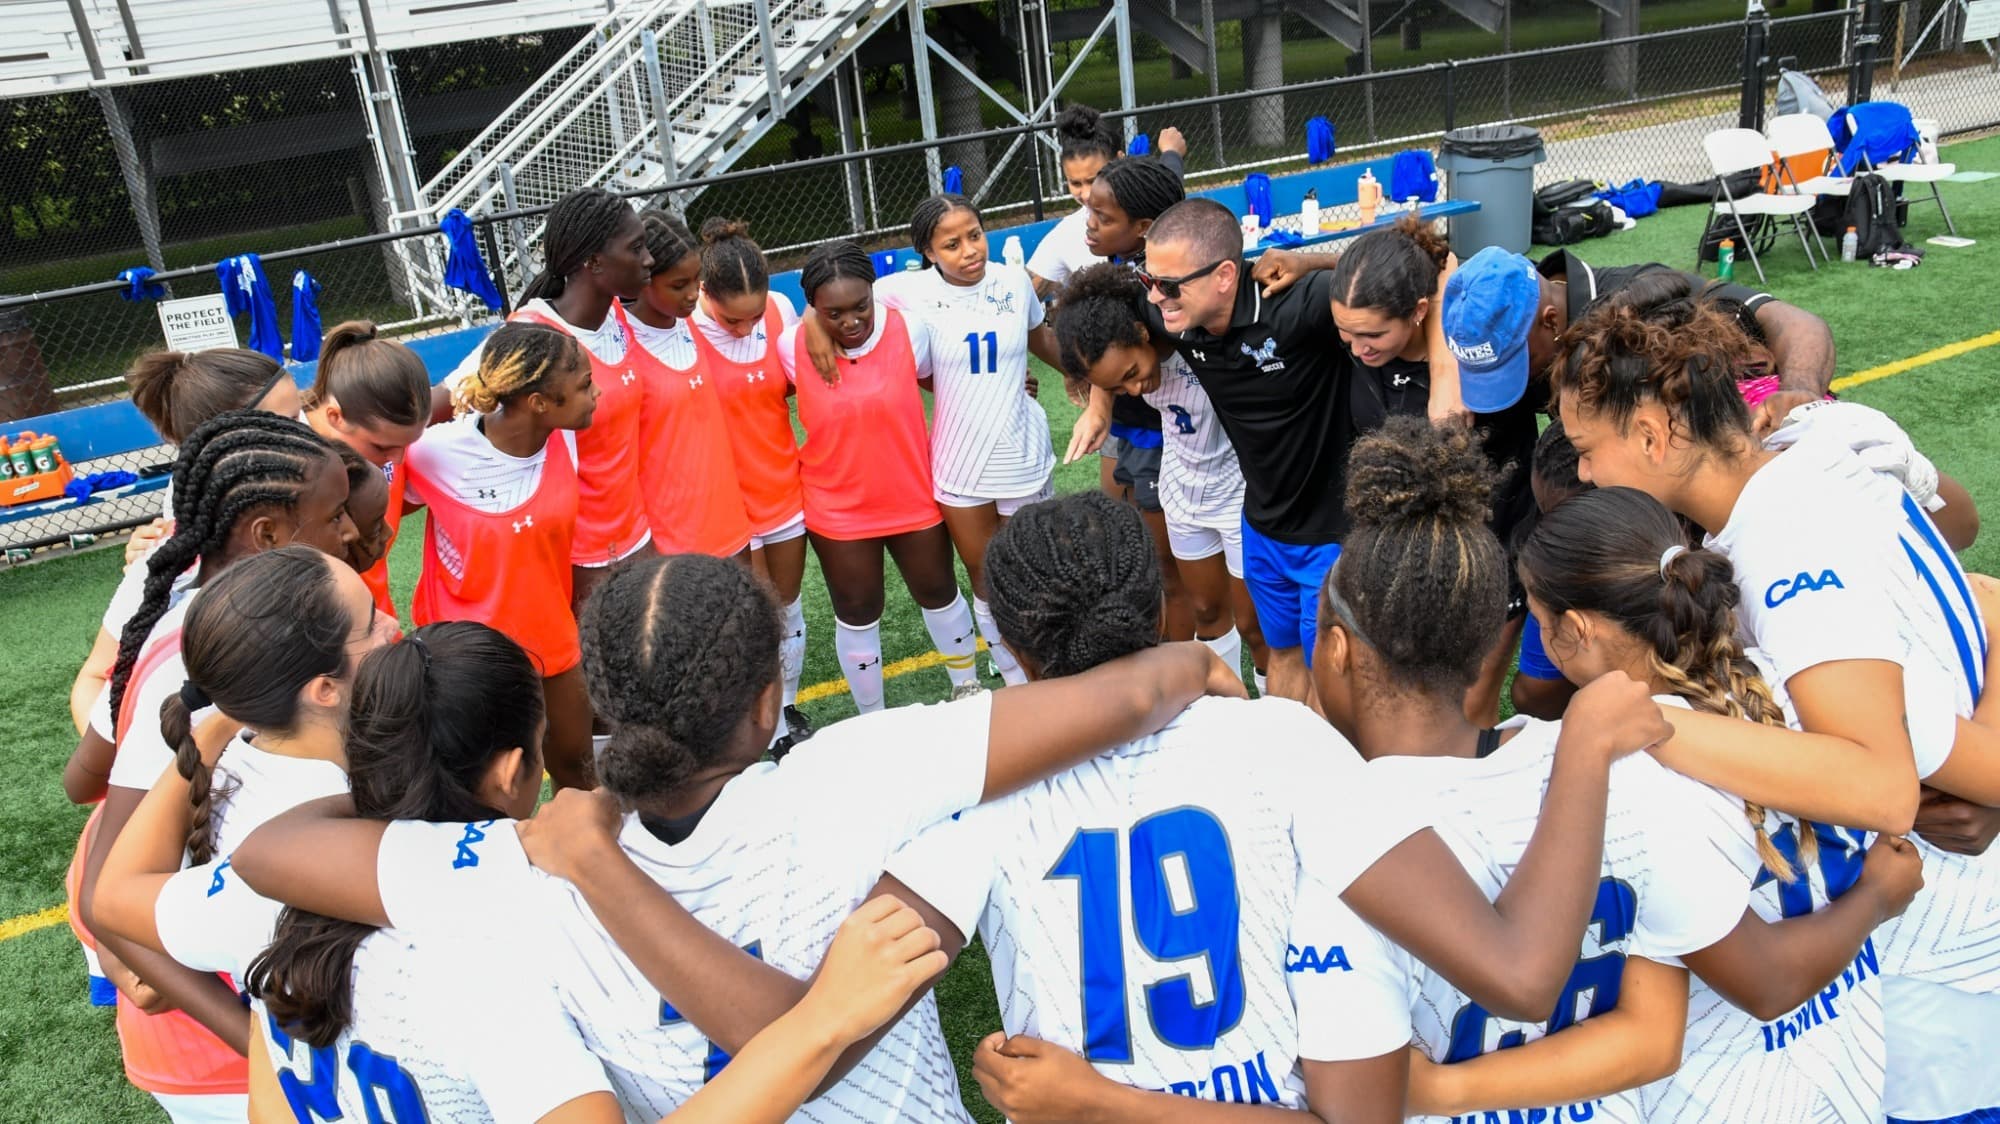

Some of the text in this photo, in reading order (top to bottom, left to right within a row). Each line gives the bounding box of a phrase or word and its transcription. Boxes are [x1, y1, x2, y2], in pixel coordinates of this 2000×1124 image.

[166, 307, 223, 323] PROTECT
[169, 316, 225, 331] THE FIELD
[963, 331, 998, 375] 11
[1764, 569, 1845, 609] CAA
[1042, 804, 1247, 1064] 19
[1285, 943, 1354, 974] CAA
[1442, 875, 1638, 1065] 6
